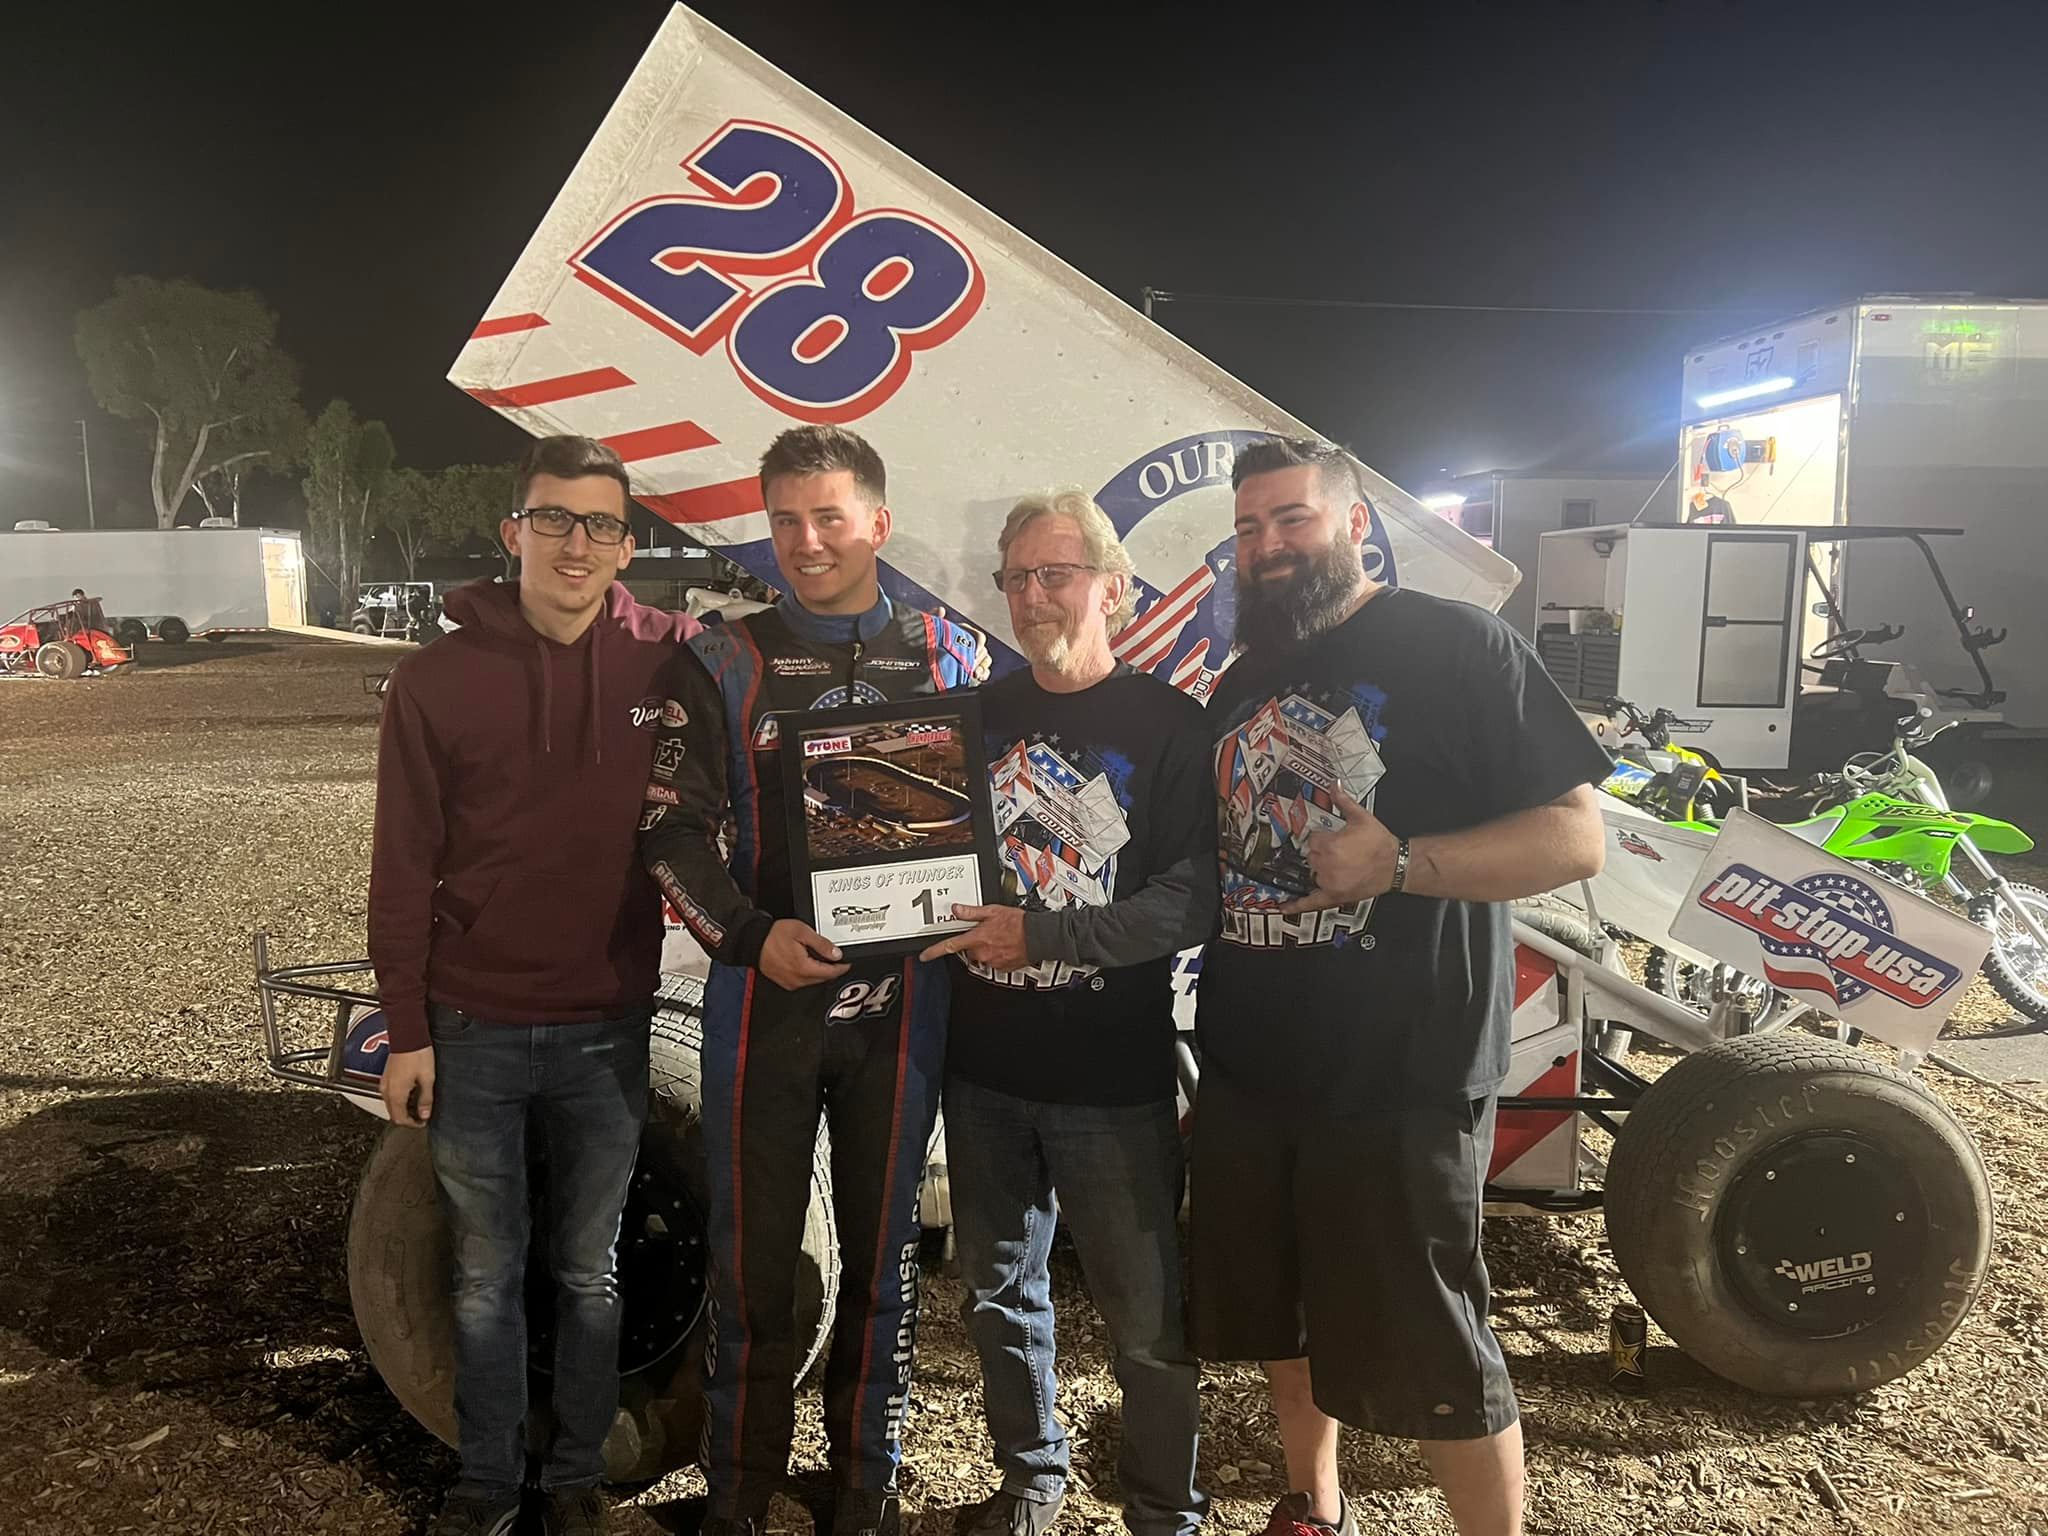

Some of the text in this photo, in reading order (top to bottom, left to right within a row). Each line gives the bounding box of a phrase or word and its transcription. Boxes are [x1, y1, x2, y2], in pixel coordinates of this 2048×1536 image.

[566, 118, 986, 425] 28
[1290, 760, 1331, 789] QUINN
[1037, 811, 1082, 847] QUINN
[828, 865, 966, 893] KINGS OF THUNDER
[936, 914, 958, 923] PLA
[1220, 896, 1375, 946] UINN
[827, 975, 899, 1021] 24
[1795, 1251, 1872, 1283] WELD
